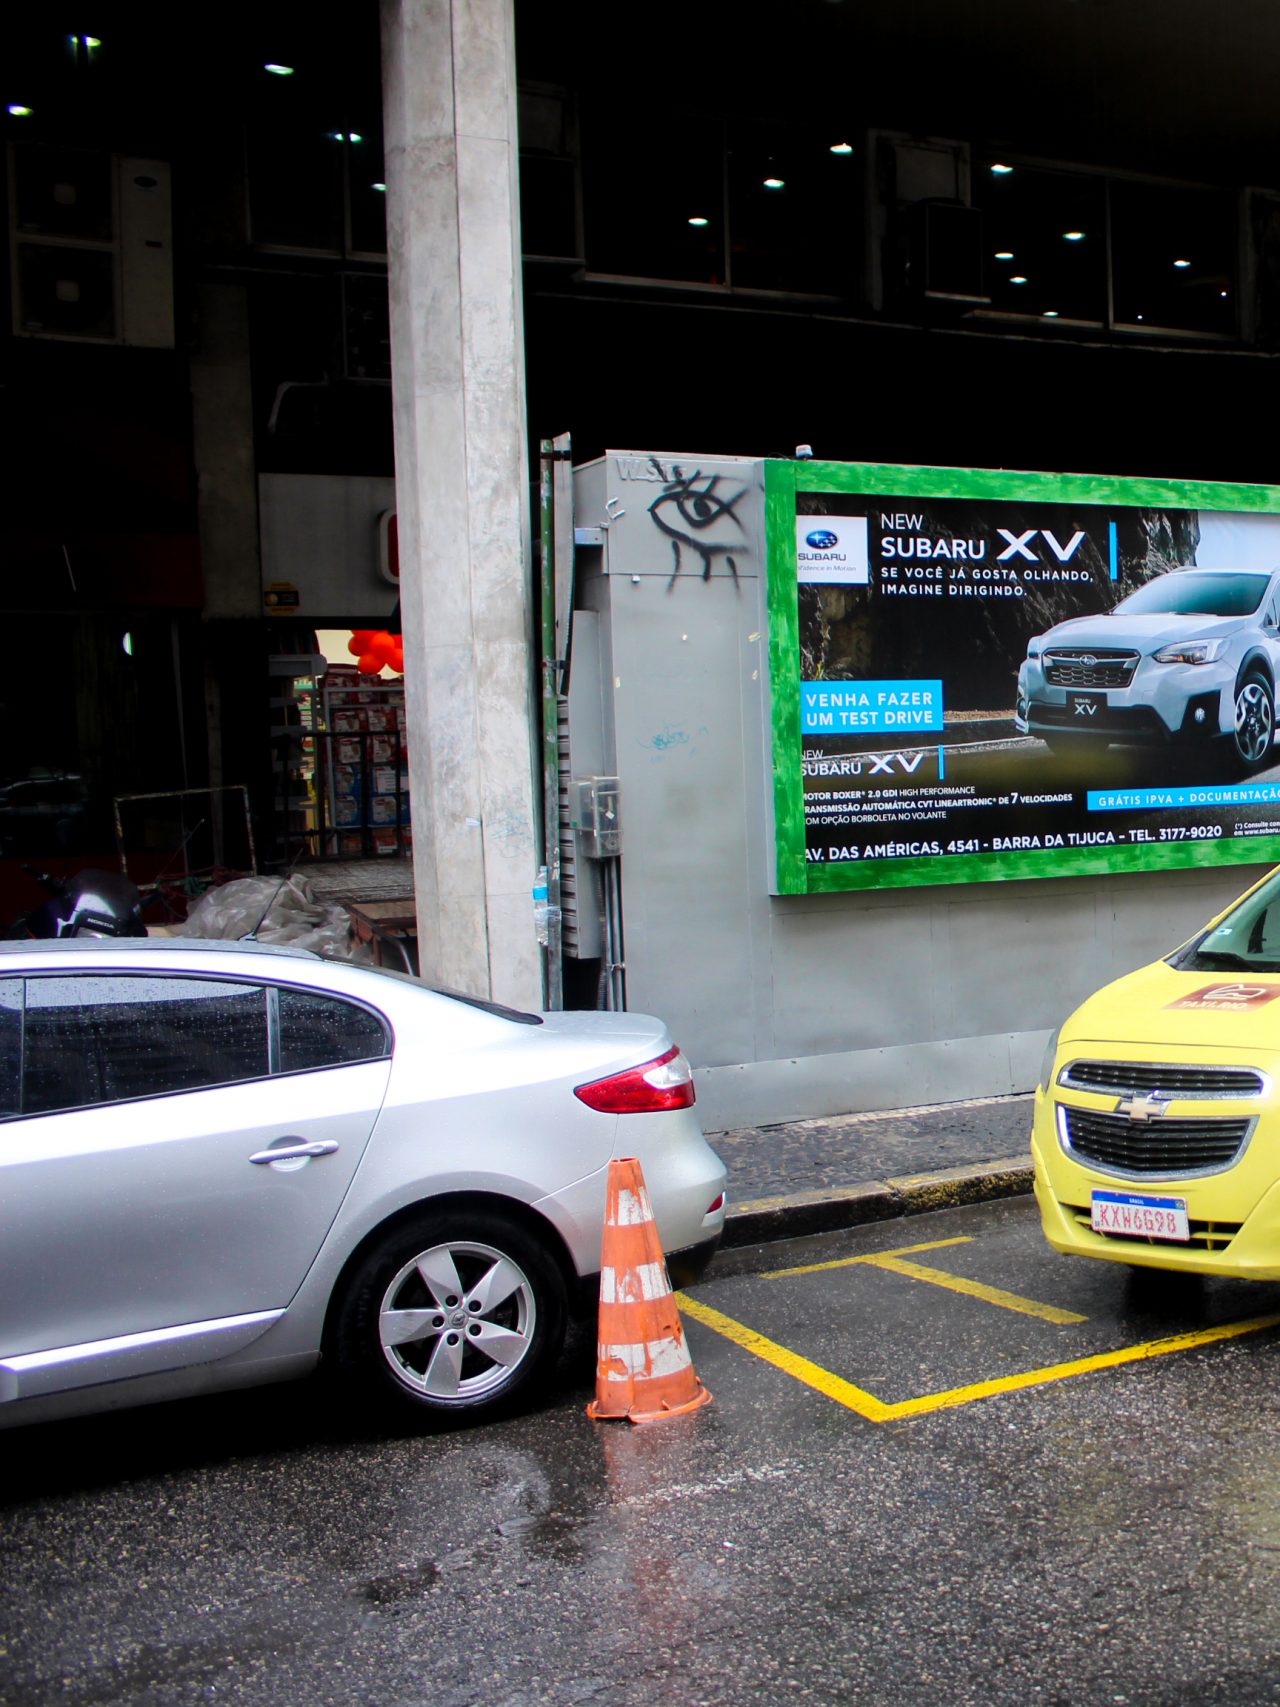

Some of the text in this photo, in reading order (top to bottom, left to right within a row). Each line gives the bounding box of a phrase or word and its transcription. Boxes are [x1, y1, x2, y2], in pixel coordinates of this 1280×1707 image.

[881, 513, 923, 530] NEW
[881, 528, 1086, 562] SUBARU XV
[798, 551, 847, 562] SUBARU
[881, 565, 1094, 583] SE VOCÊ JÁ GOSTA OLHANDO,
[881, 584, 1028, 597] IMAGINE DIRIGINDO.
[806, 692, 933, 707] VENHA FAZER
[1074, 704, 1097, 716] XV
[806, 710, 934, 727] UM TEST DRIVE
[802, 753, 924, 776] SUBARU XV
[867, 790, 881, 798] 2.0
[899, 788, 919, 797] HIGH
[920, 786, 976, 796] PERFORMANCE
[1098, 792, 1141, 807] GRÁTIS
[1146, 793, 1173, 805] IPVA
[1178, 795, 1185, 803] +
[804, 802, 861, 814] RANSMISSÃO
[861, 799, 917, 811] AUTOMÁTICA
[917, 799, 934, 808] CVT
[998, 796, 1009, 805] DE
[1010, 792, 1019, 804] 7
[1020, 793, 1073, 804] VELOCIDADES
[805, 810, 947, 826] OM OPÇÃO BORBOLETA NO VOLANTE
[1243, 821, 1269, 829] Consulte
[805, 848, 825, 862] AV.
[829, 845, 859, 860] DAS
[863, 839, 944, 859] AMÉRICAS,
[947, 839, 980, 854] 4541
[993, 835, 1041, 850] BARRA
[1045, 834, 1064, 847] DA
[1067, 830, 1116, 845] TIJUCA
[1129, 828, 1156, 843] TEL.
[1159, 824, 1223, 841] 3177-9020
[1099, 1203, 1177, 1234] KXW6G98
